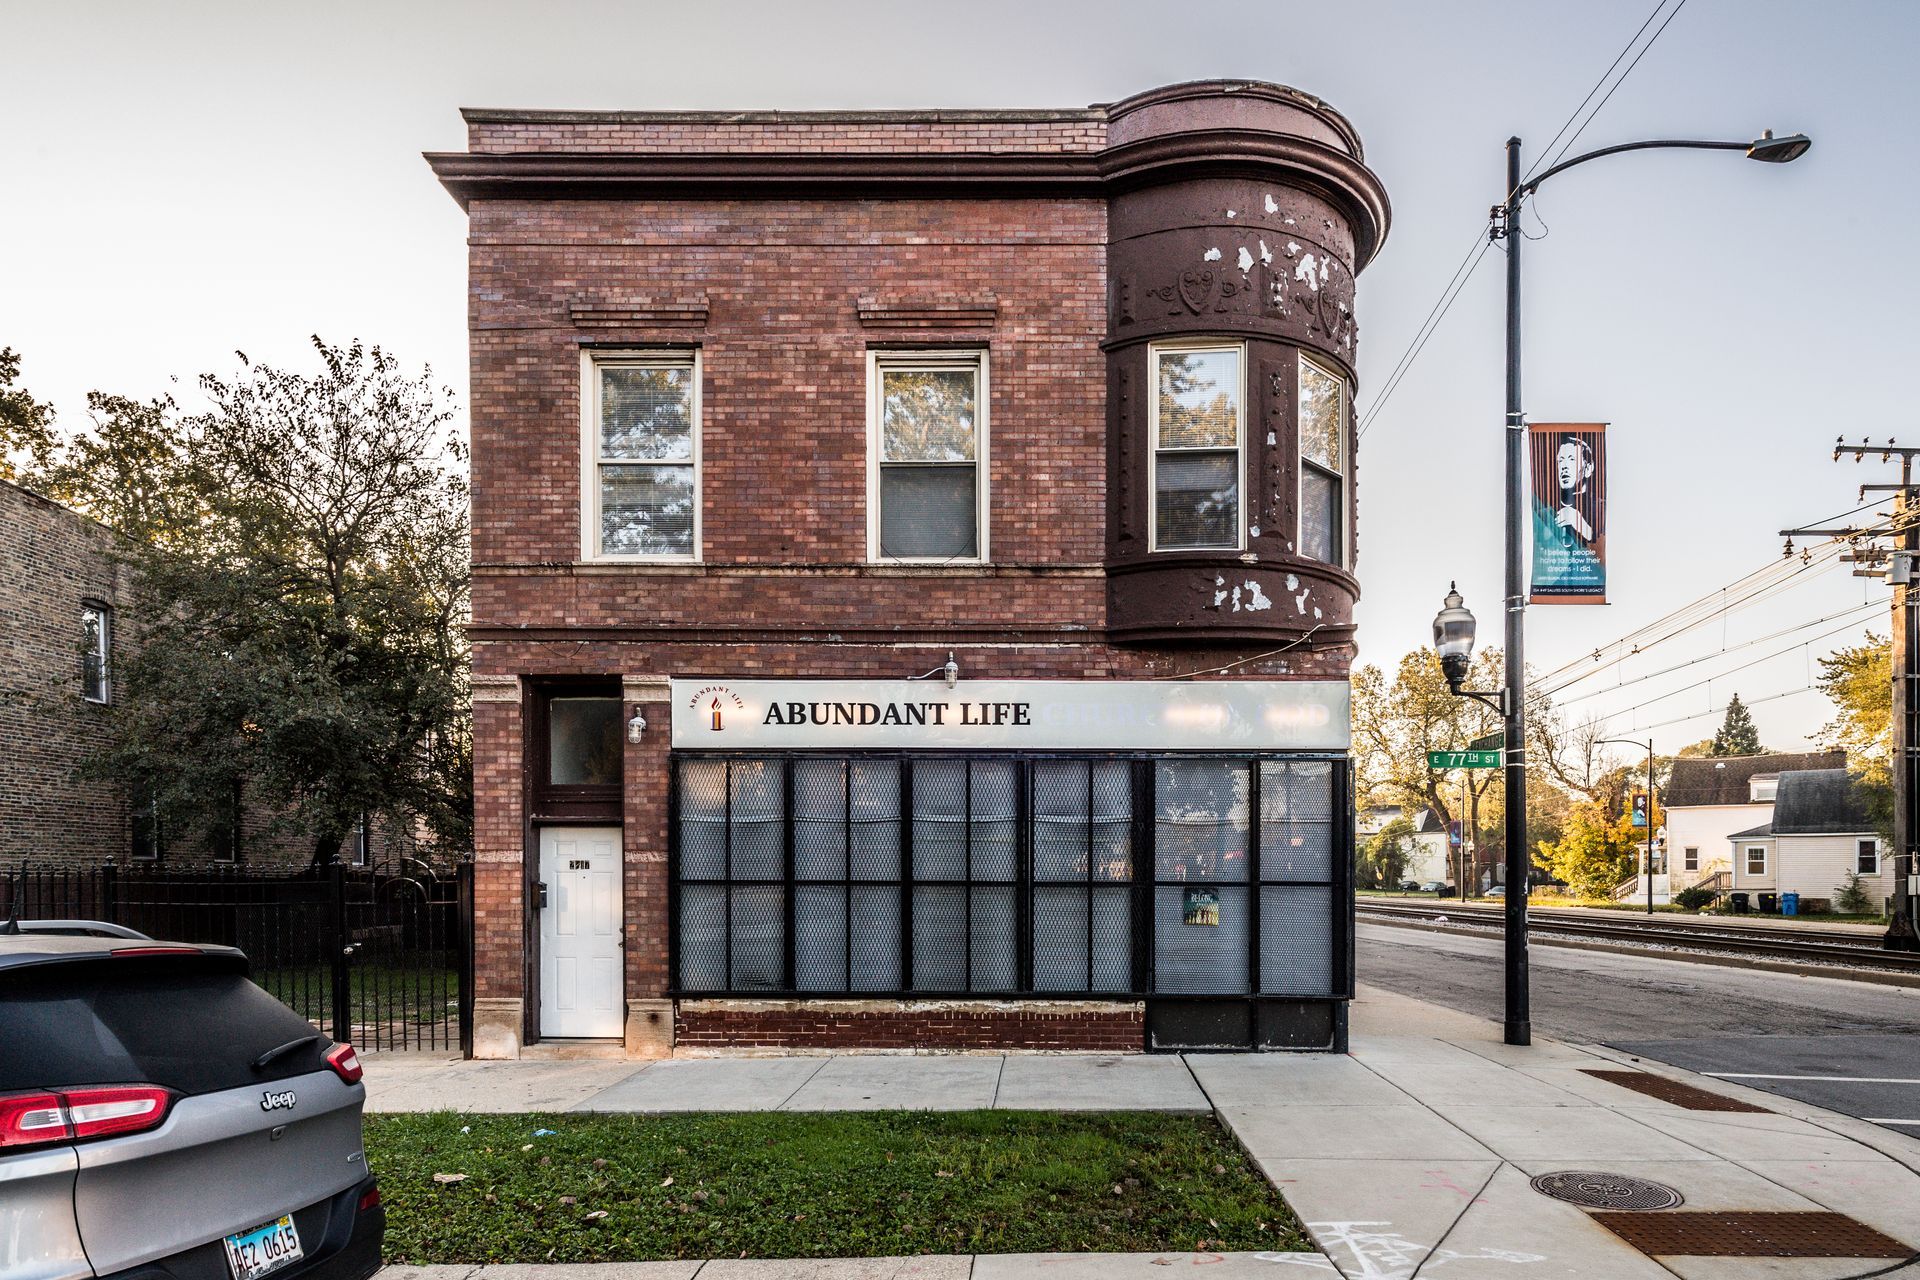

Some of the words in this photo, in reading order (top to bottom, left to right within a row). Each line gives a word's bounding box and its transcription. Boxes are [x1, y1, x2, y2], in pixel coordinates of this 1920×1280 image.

[689, 686, 729, 709] ABUNDANT
[763, 702, 949, 726] ABUNDANT
[960, 702, 1031, 726] LIFE
[1448, 753, 1479, 766] 77TH
[1485, 755, 1496, 763] ST
[261, 1090, 297, 1112] Jeep
[234, 1241, 260, 1274] AE2
[262, 1227, 297, 1260] 0615
